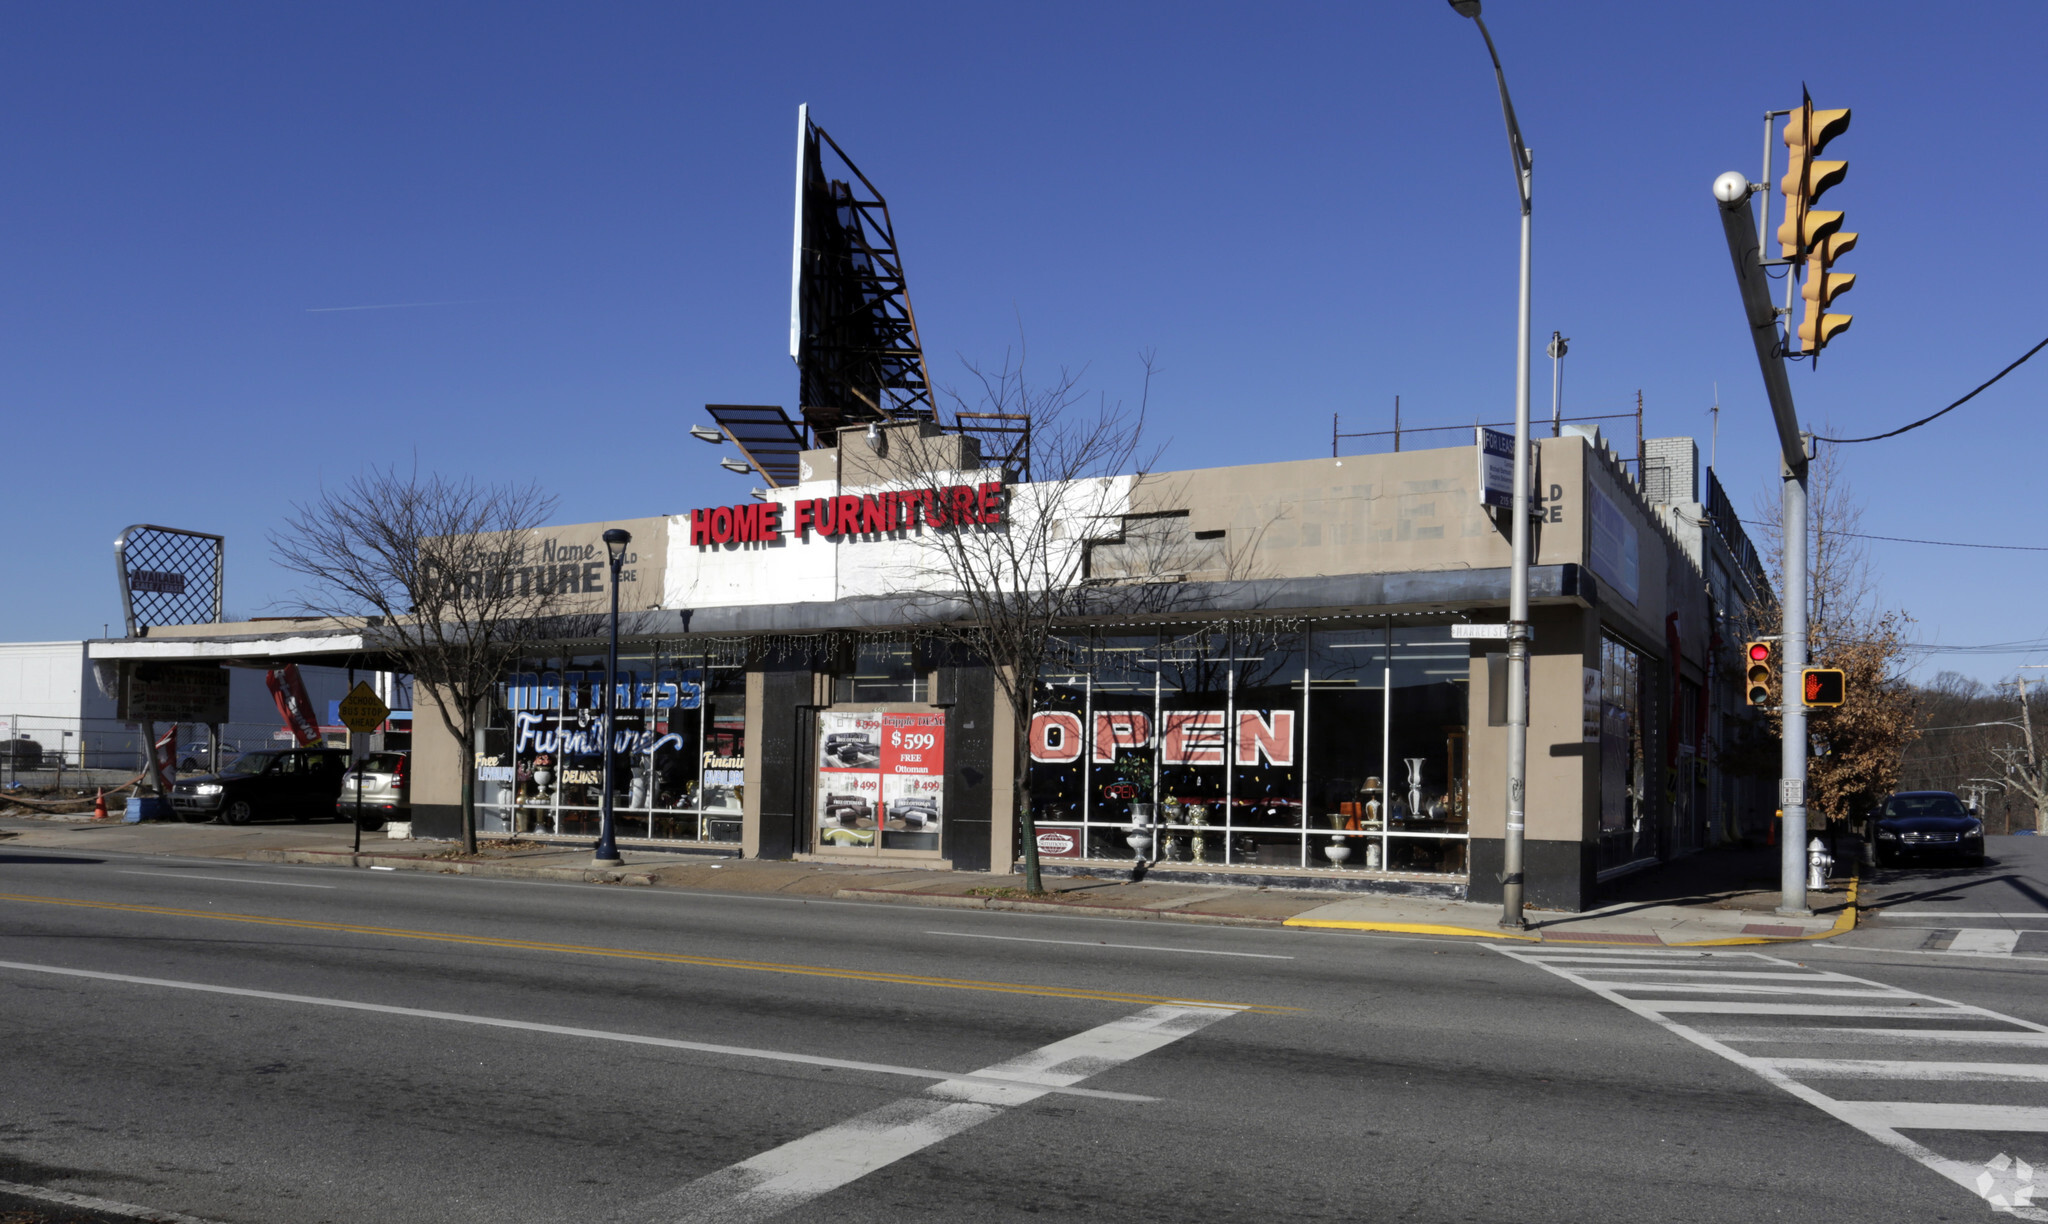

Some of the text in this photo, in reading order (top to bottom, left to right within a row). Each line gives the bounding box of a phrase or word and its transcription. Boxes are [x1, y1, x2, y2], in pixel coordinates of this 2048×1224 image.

[1485, 431, 1515, 454] FOR LEAS
[691, 482, 1006, 546] HOME FURNITURE
[542, 539, 602, 562] Name
[1456, 626, 1504, 637] MARKET ST
[507, 671, 701, 710] MATTRESS
[348, 696, 378, 706] SCHOOL
[342, 707, 382, 716] BUS STOP
[351, 717, 375, 726] AHEAD
[883, 716, 914, 729] Tripple
[1029, 710, 1295, 766] OPEN
[474, 751, 500, 769] Free
[900, 753, 922, 762] FREE
[895, 765, 929, 773] Ottoman
[704, 769, 744, 786] AVAILABL
[1103, 784, 1138, 799] OPEN
